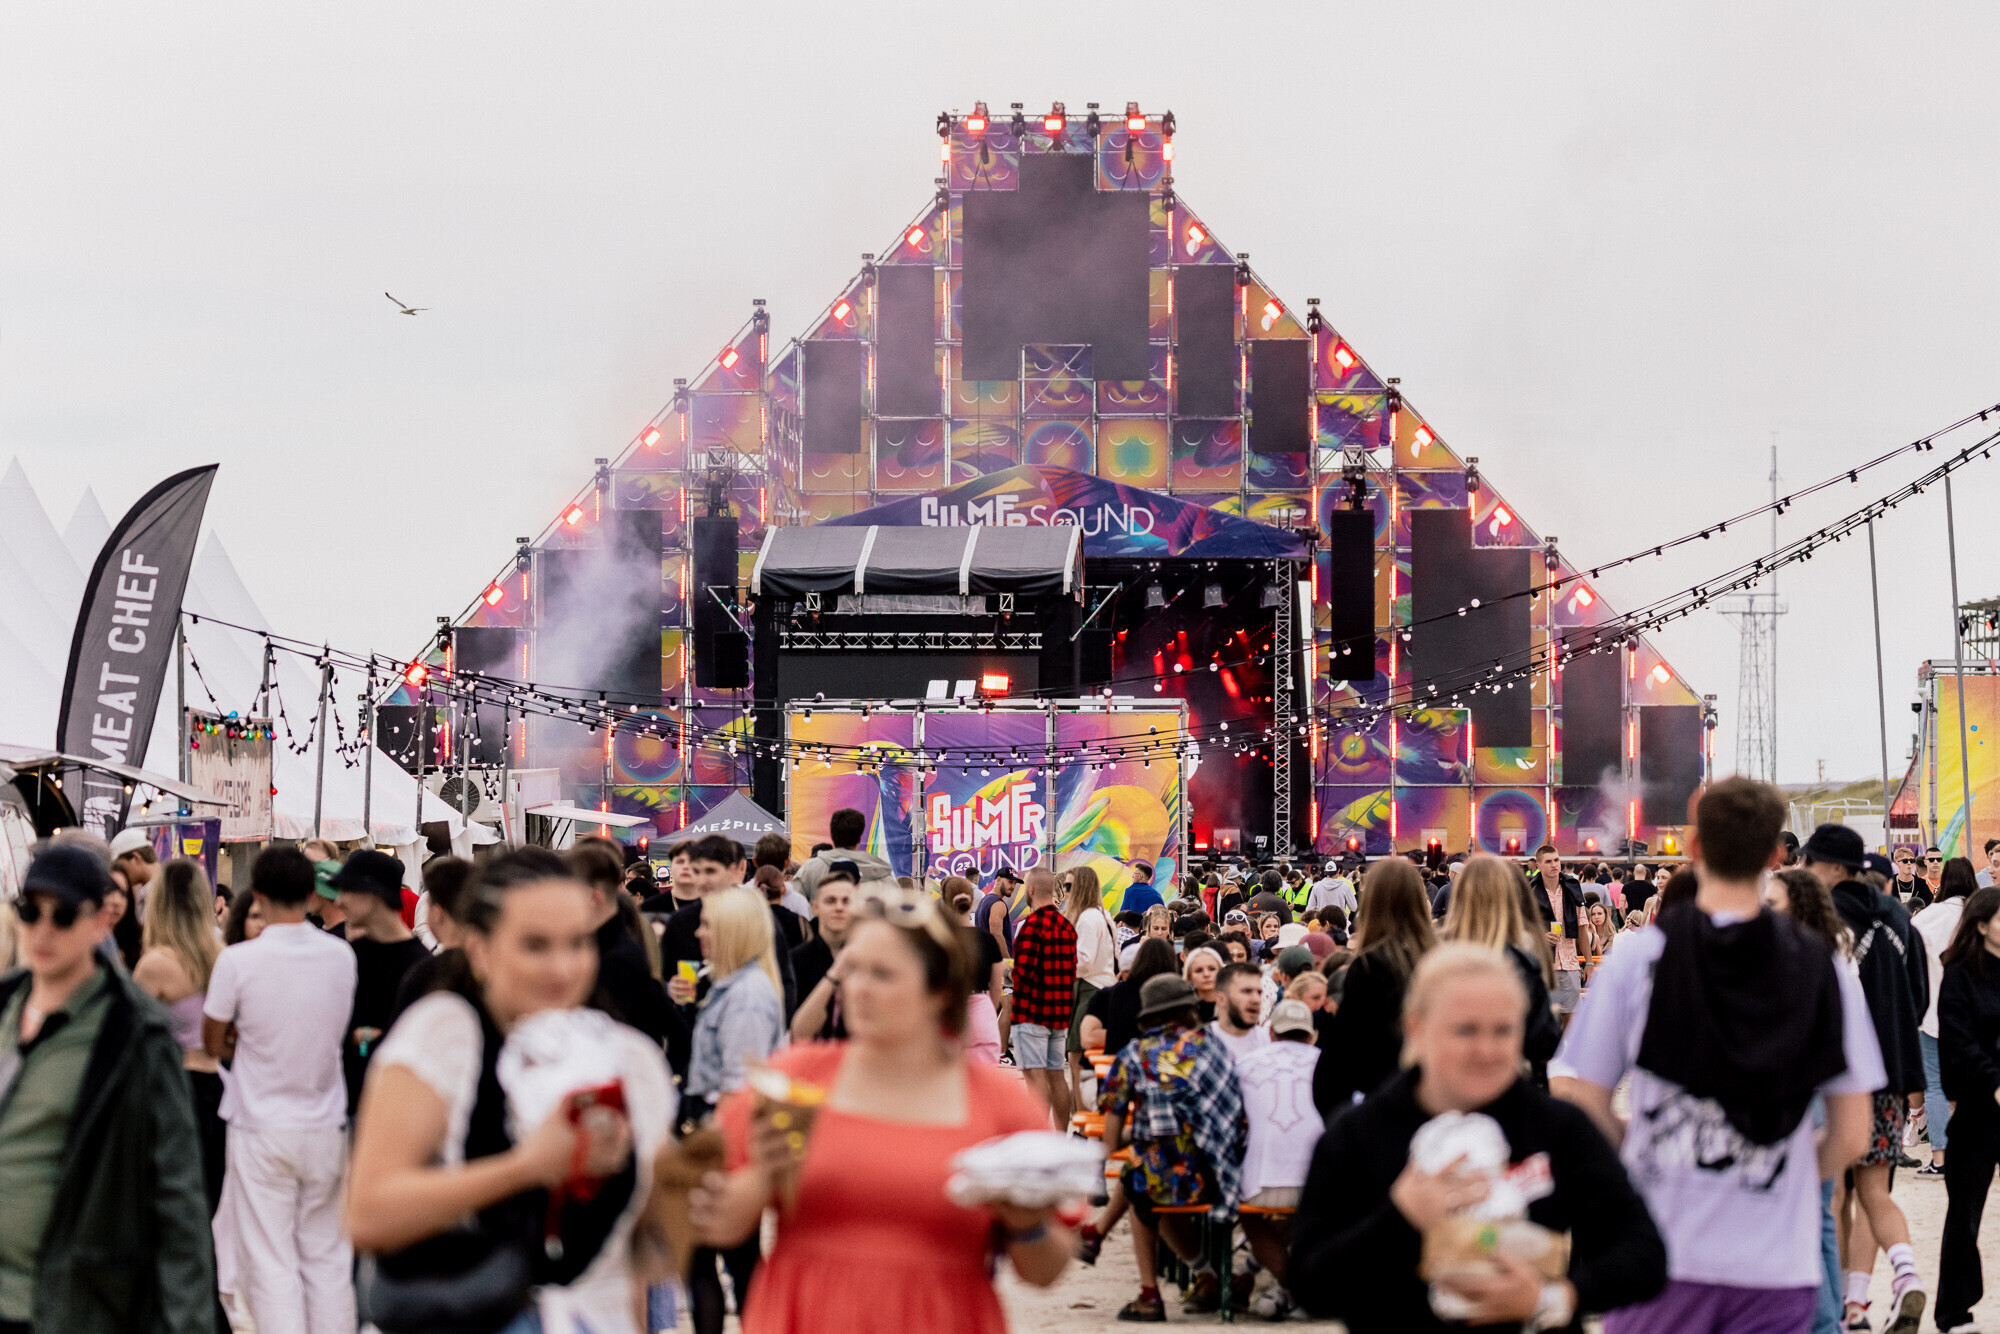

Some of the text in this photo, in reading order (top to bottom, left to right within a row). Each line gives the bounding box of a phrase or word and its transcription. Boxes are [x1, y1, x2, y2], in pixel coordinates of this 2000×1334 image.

[921, 494, 1155, 536] SUME SOUND
[90, 549, 160, 768] MEAT CHEF
[691, 818, 774, 834] MEŽPILS
[930, 781, 1046, 854] SUMMER
[934, 844, 1042, 878] SOUND
